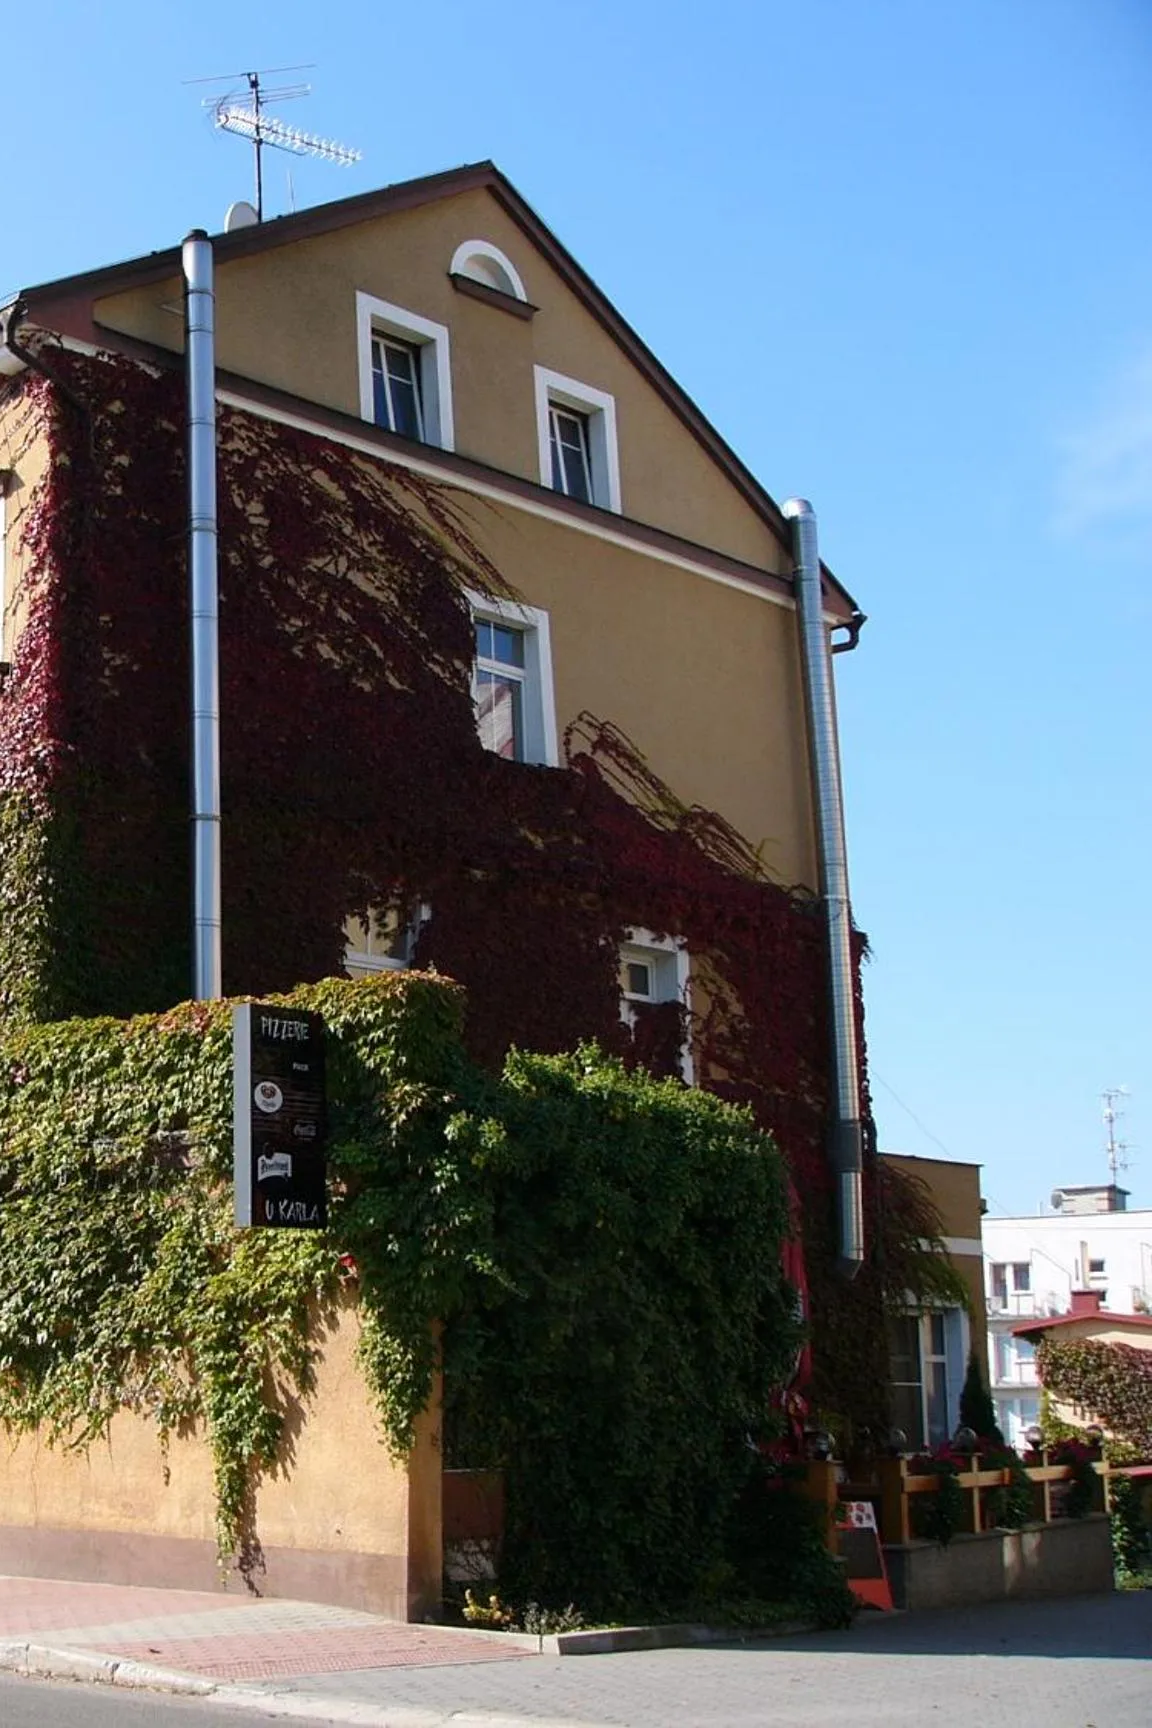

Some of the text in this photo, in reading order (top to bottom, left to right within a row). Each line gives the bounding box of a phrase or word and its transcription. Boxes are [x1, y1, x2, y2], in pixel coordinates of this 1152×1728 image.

[260, 1016, 310, 1040] PIZZERIE
[265, 1198, 319, 1222] U KARLA
